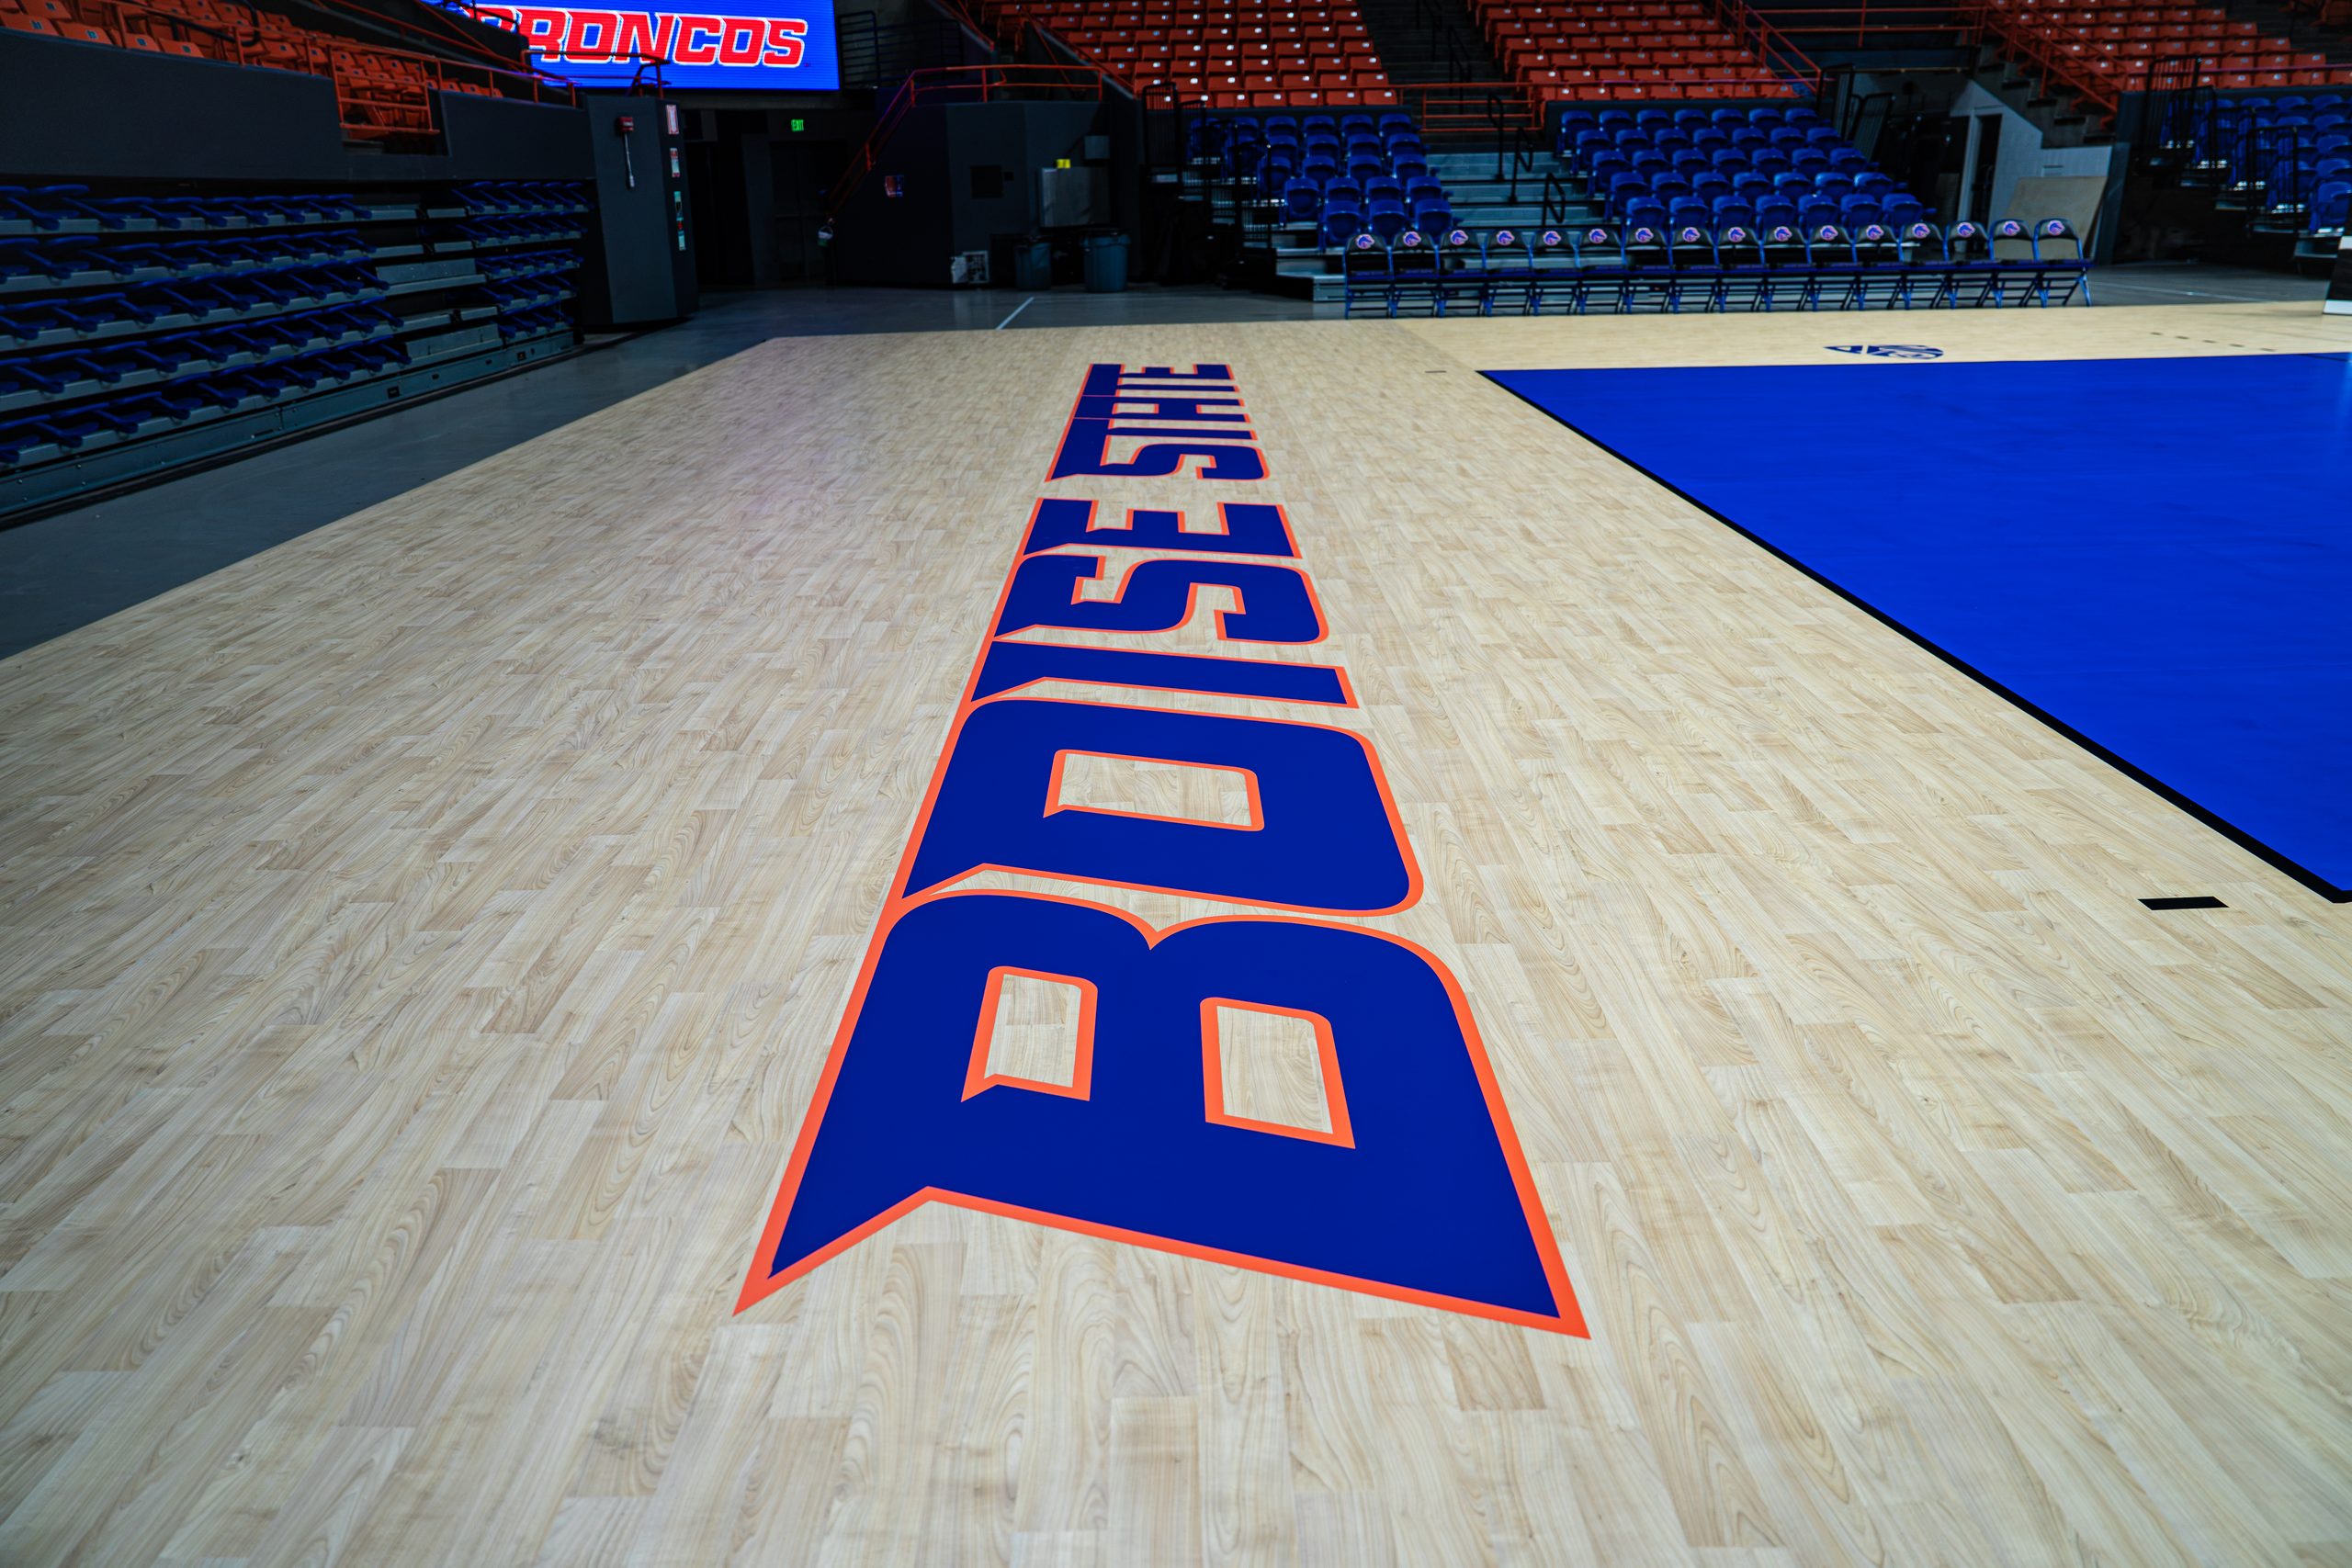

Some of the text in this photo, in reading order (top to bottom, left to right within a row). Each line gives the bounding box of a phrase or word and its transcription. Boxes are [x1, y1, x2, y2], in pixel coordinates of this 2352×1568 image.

[791, 119, 805, 131] EXIT
[732, 363, 1591, 1340] BOISE STATE
